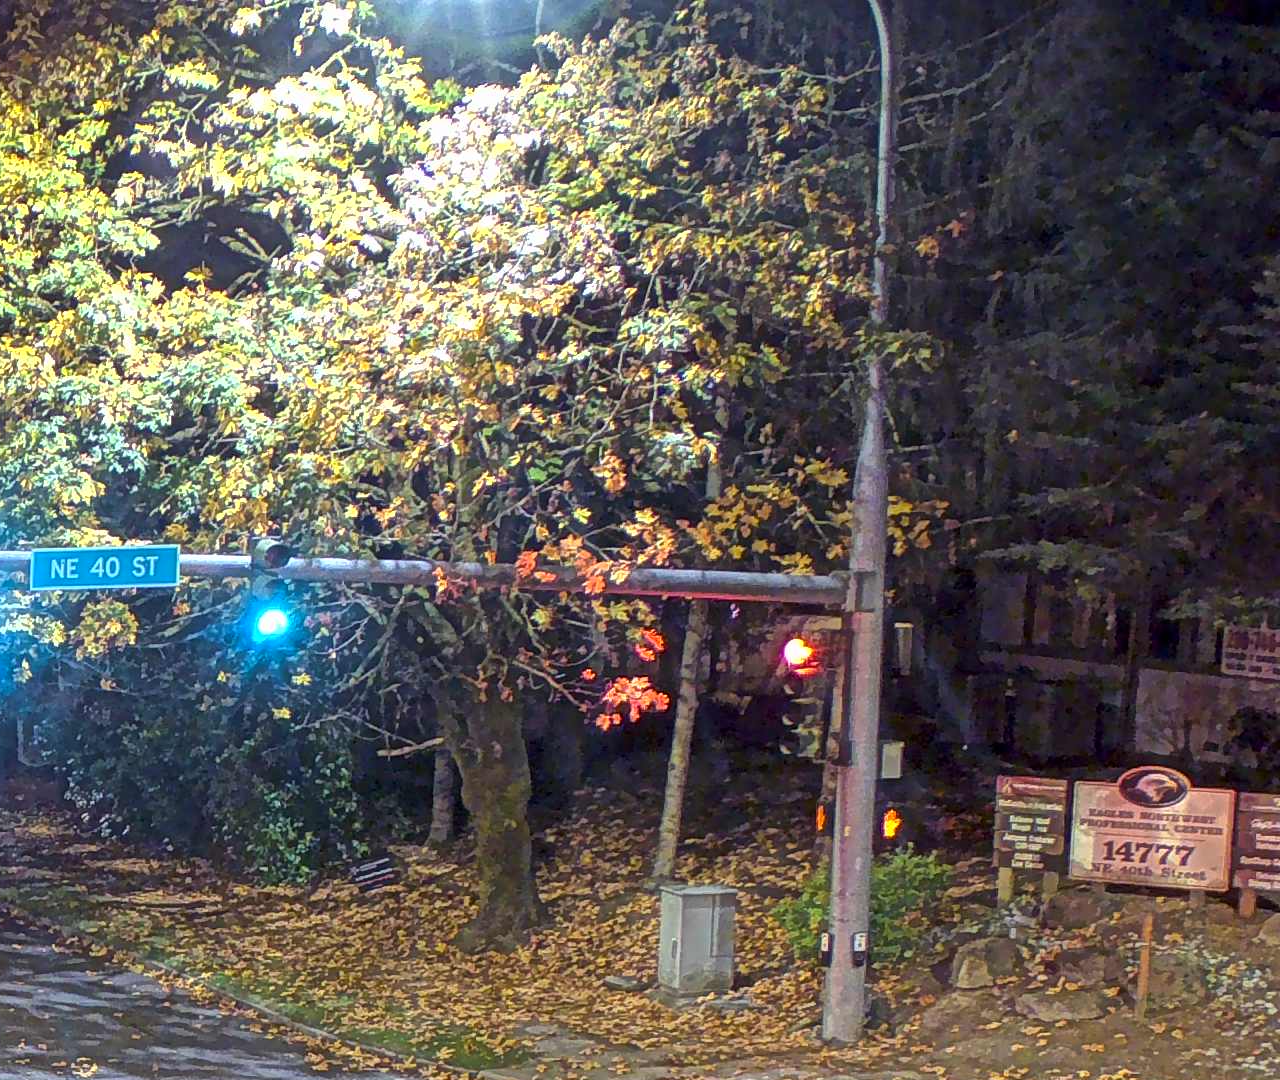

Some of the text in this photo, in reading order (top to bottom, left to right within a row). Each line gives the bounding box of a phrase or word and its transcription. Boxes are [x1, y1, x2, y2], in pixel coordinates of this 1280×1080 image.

[50, 555, 159, 579] NE 40 ST
[1102, 840, 1196, 866] 14777
[1119, 865, 1153, 877] 40th
[1160, 867, 1208, 881] Street
